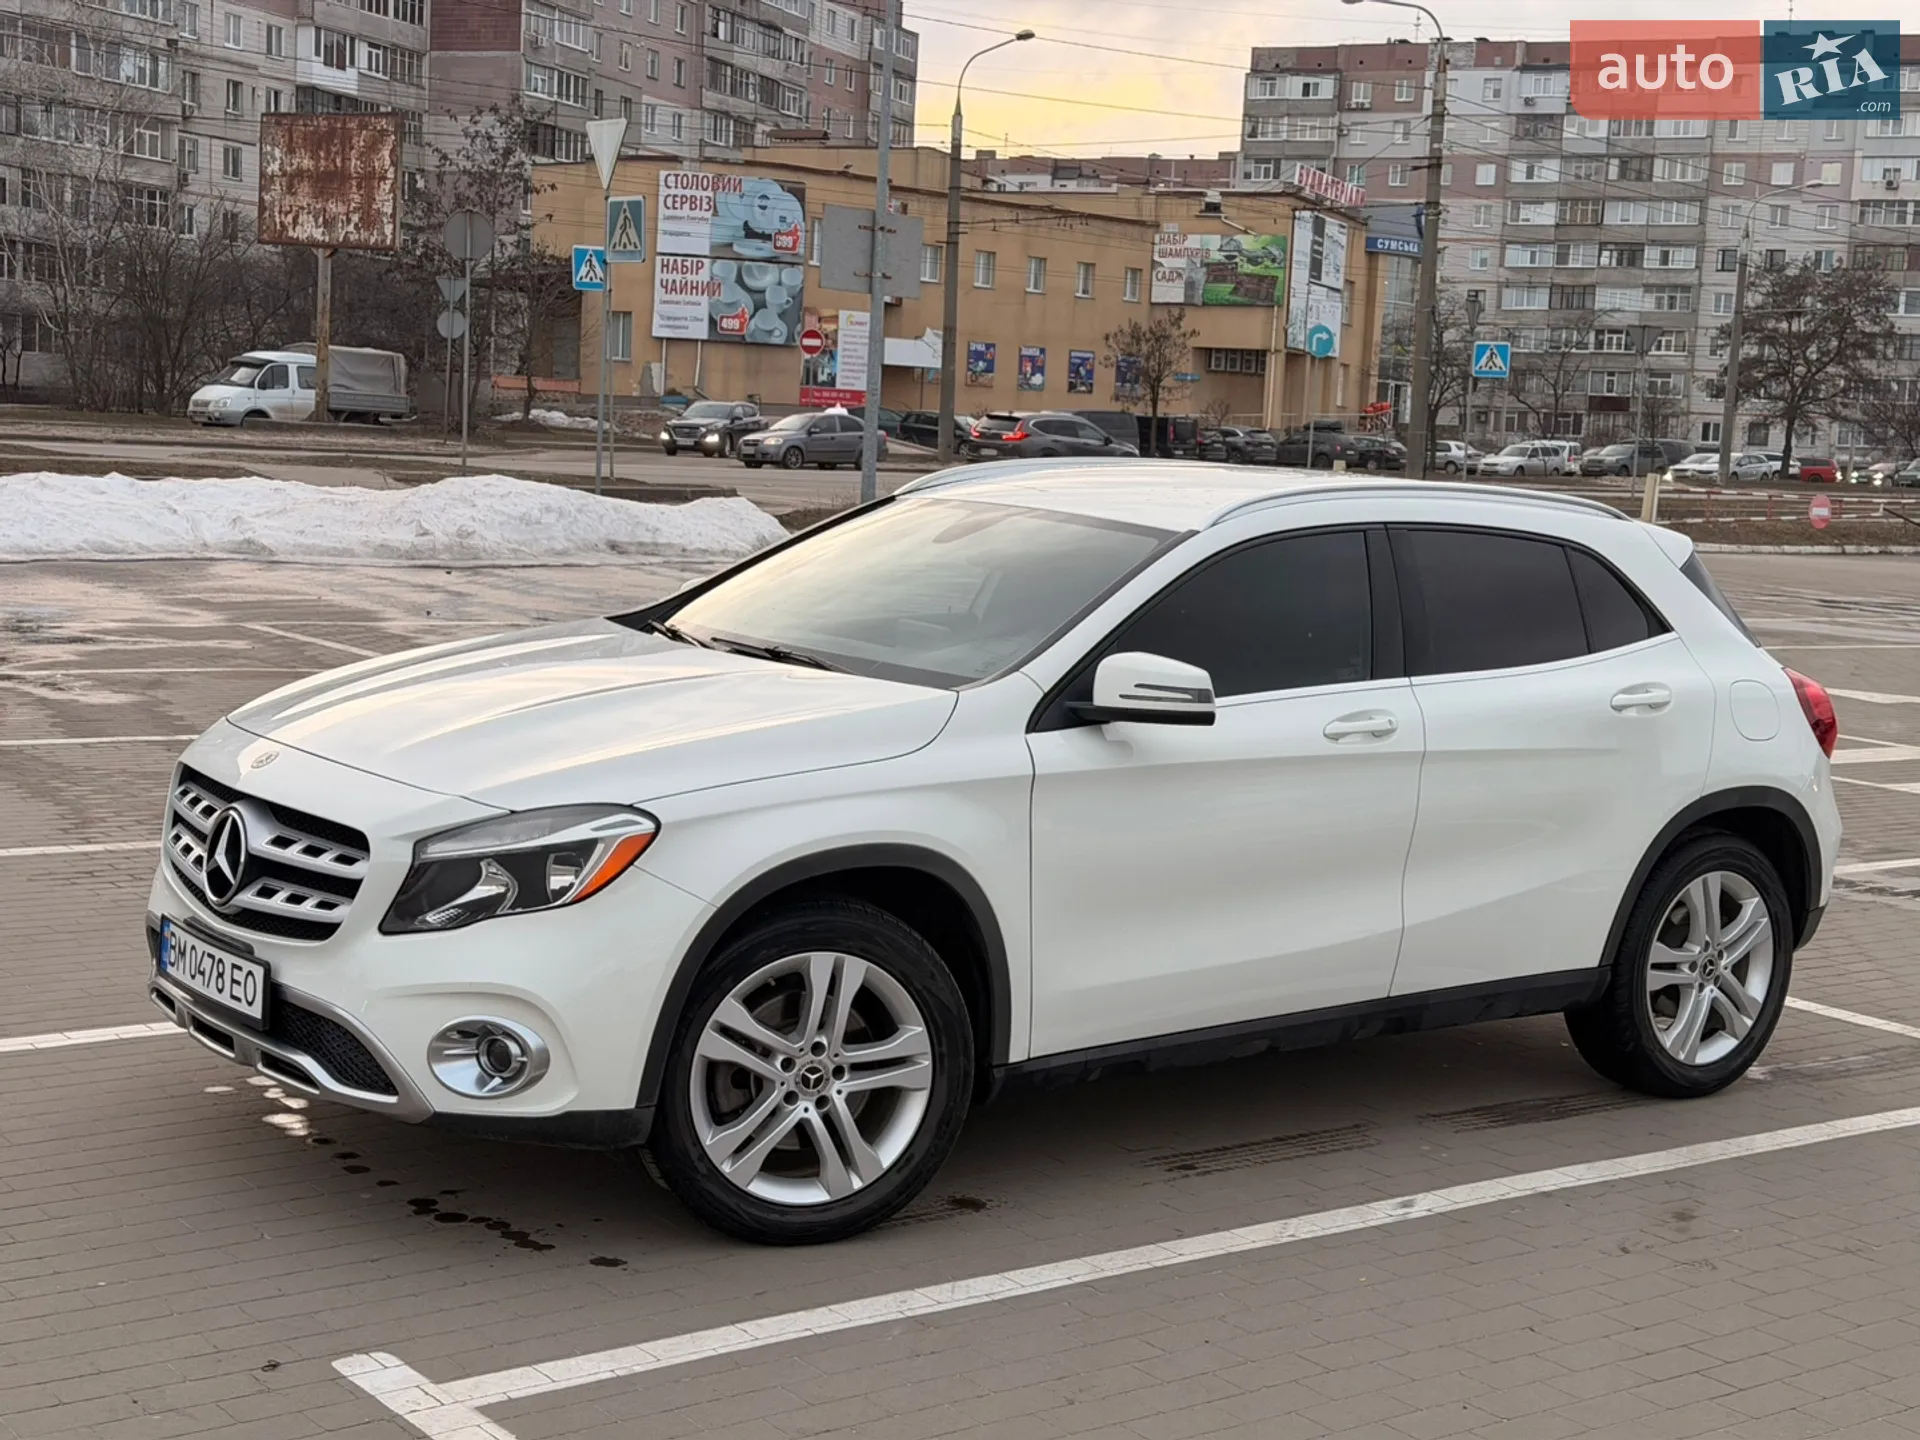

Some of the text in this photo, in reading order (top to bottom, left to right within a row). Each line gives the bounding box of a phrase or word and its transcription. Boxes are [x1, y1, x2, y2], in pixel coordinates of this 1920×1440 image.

[663, 193, 712, 212] СЕРВІЗ
[1159, 234, 1189, 246] НАБІР
[1377, 238, 1419, 253] СУМСЬКА
[660, 258, 705, 276] НАБІР
[660, 276, 722, 298] ЧАЙНИЙ
[189, 944, 226, 994] 0478
